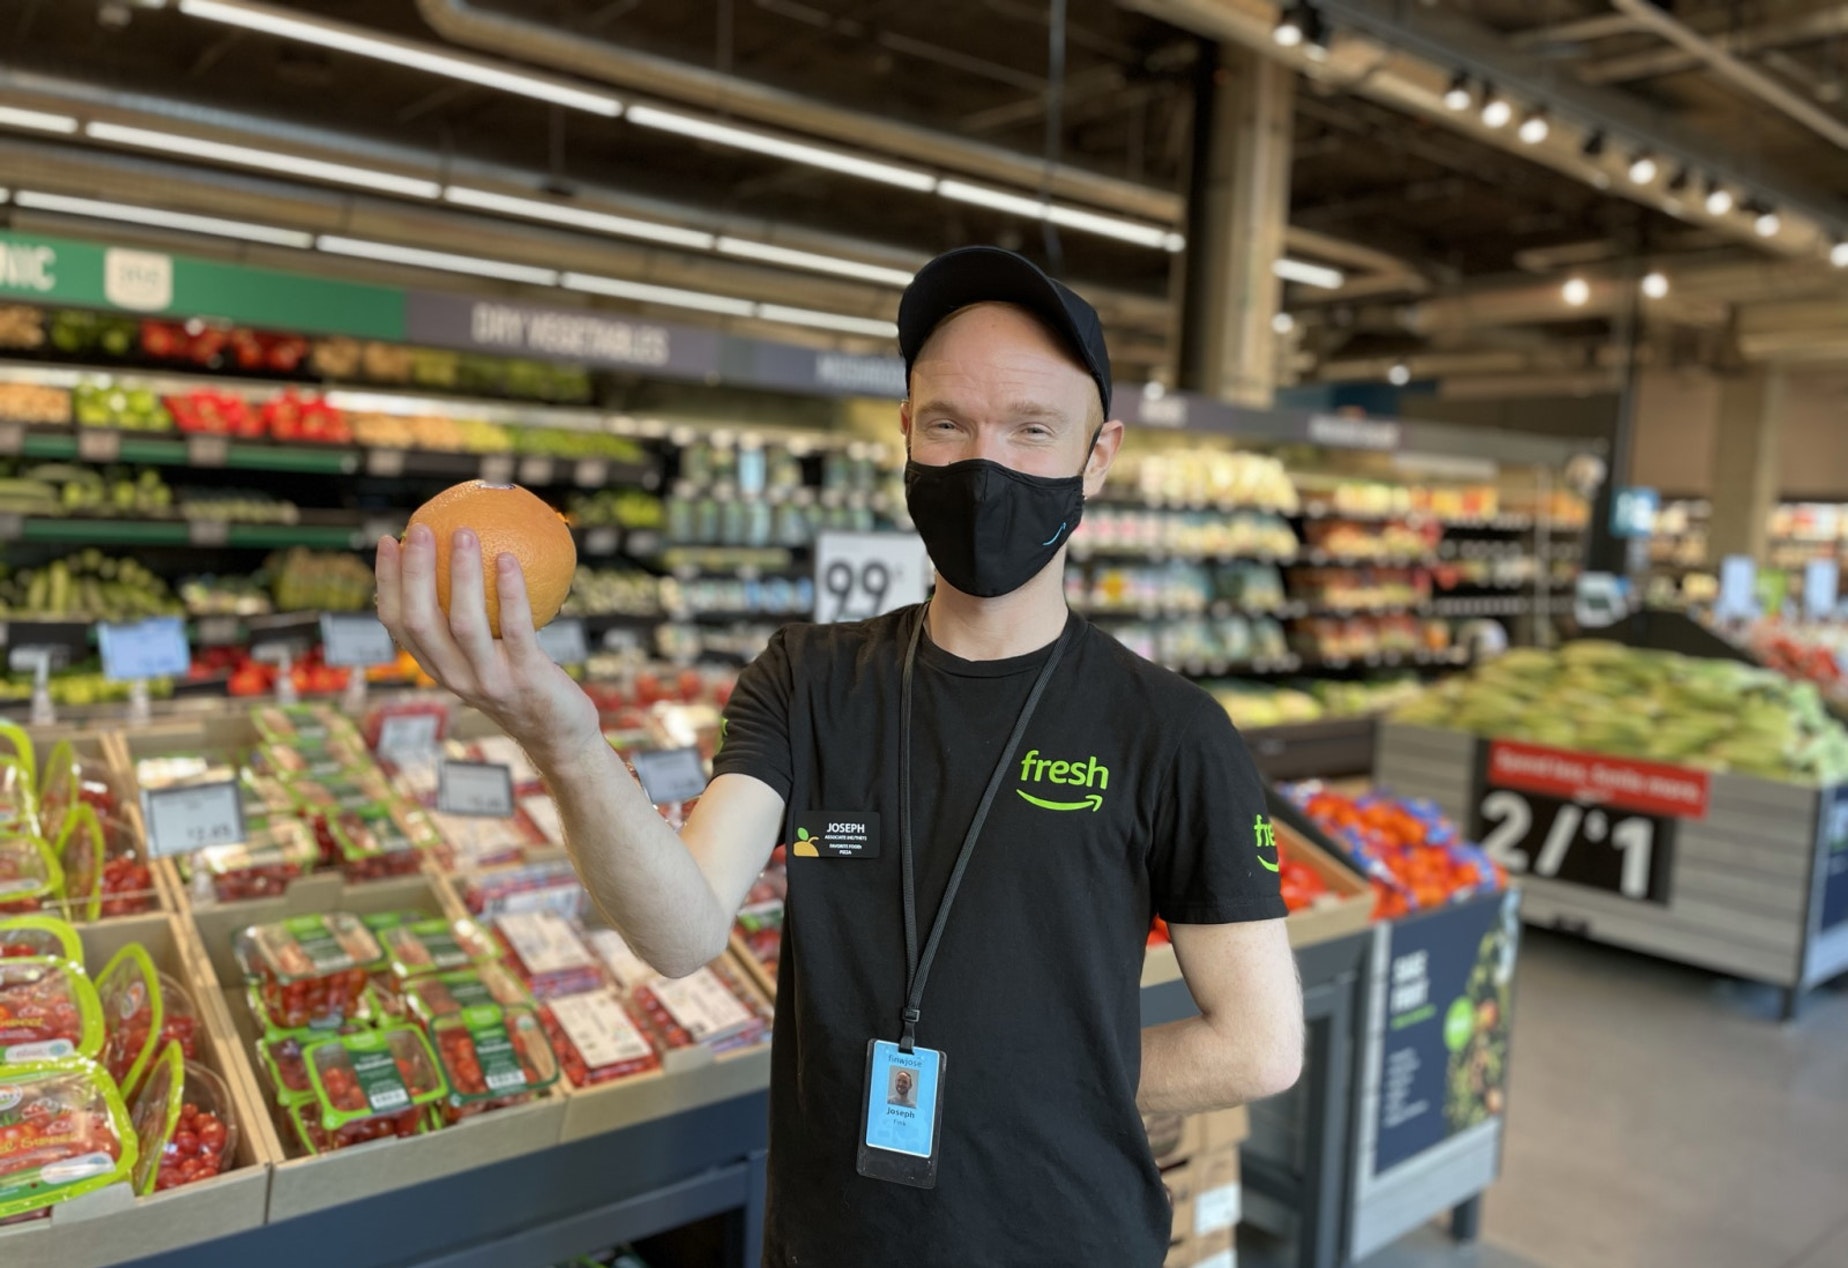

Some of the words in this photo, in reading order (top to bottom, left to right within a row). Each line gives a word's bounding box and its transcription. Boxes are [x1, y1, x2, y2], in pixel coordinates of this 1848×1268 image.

[1020, 749, 1109, 790] fresh
[827, 822, 865, 833] JOSEPH
[886, 1107, 915, 1118] Joseph
